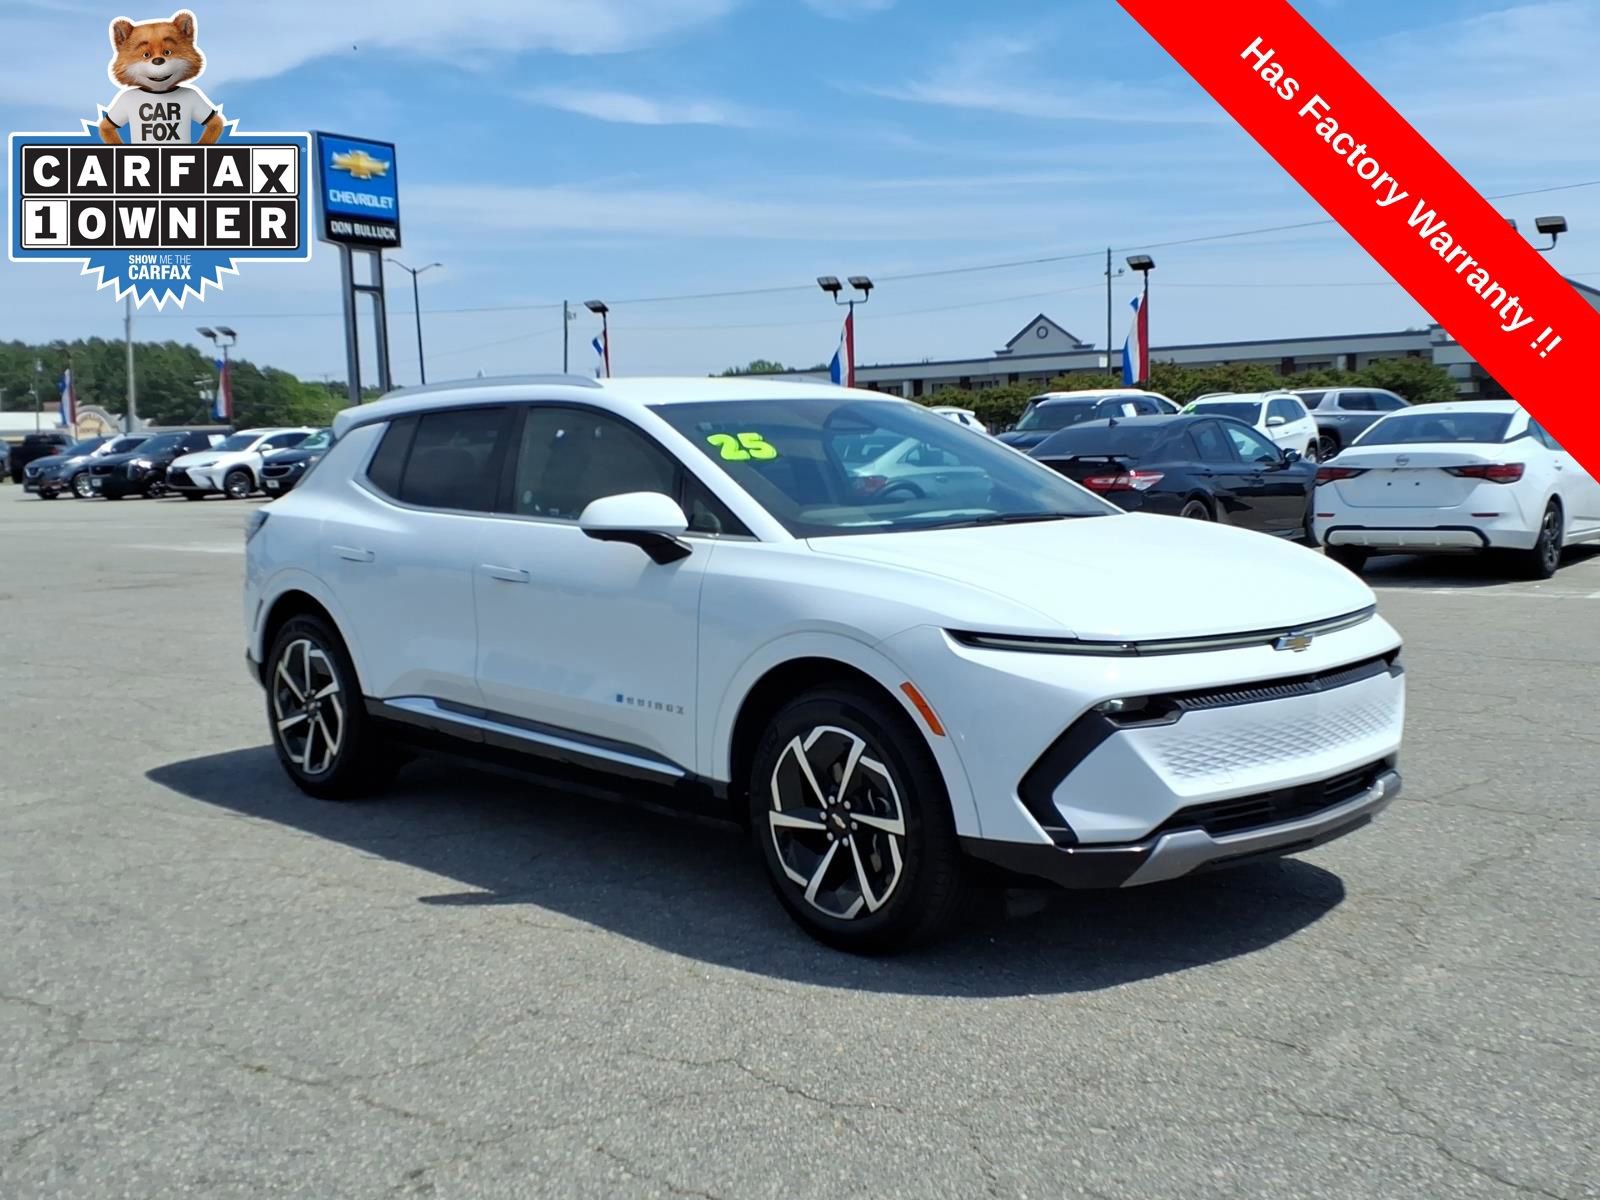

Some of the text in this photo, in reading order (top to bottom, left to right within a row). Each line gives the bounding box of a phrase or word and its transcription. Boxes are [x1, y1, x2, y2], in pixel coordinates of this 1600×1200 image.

[329, 189, 393, 209] CHEVROLET
[330, 220, 397, 240] DON BULLUCK
[706, 431, 778, 461] 25
